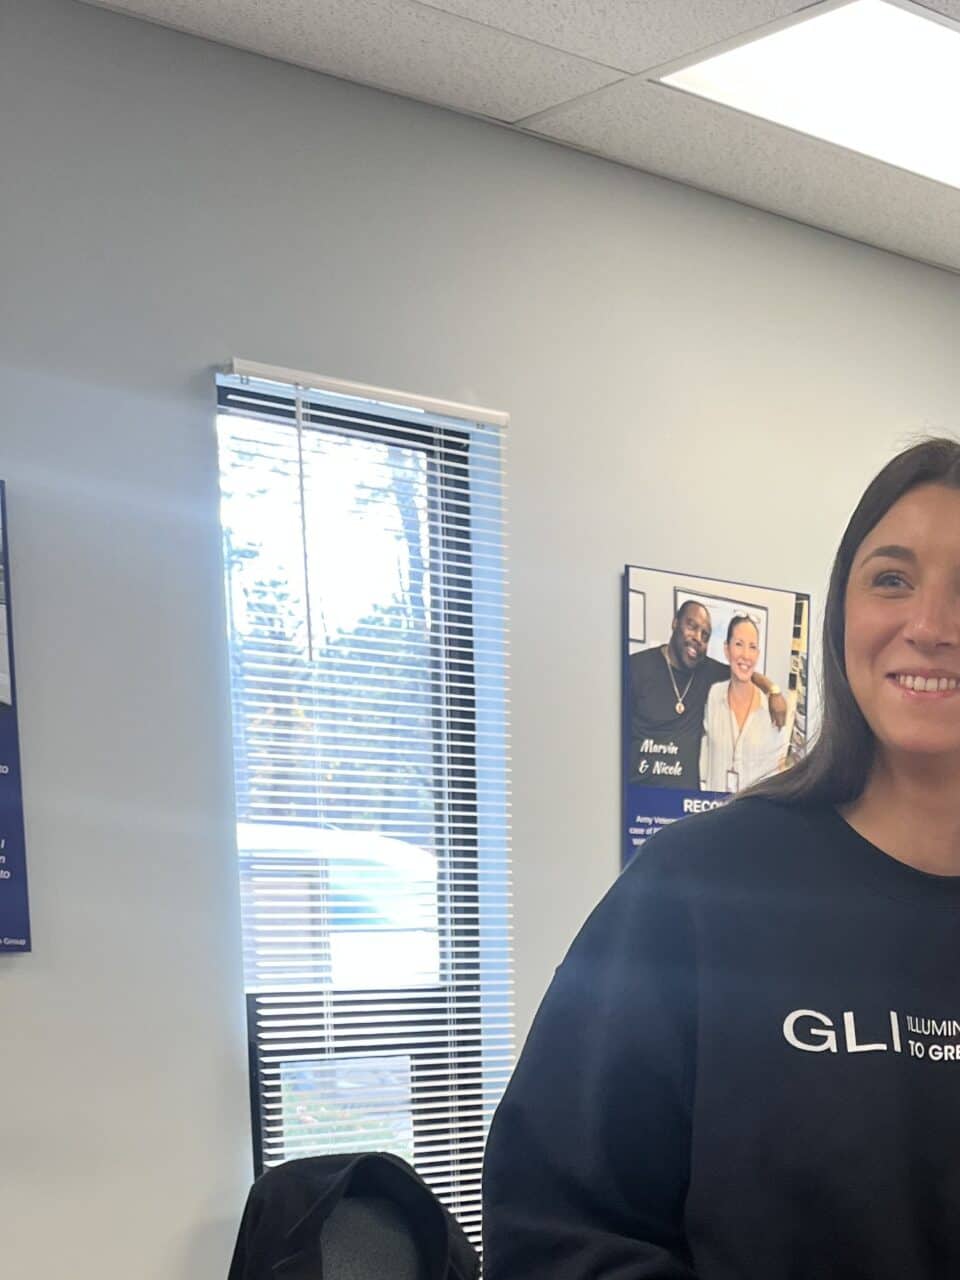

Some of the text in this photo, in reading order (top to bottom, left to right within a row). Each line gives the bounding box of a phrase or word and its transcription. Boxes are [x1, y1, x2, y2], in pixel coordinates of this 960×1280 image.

[640, 739, 678, 754] Marvin
[639, 760, 682, 776] & Nicole
[683, 799, 728, 813] RECO
[783, 1009, 902, 1053] GLI
[908, 1040, 924, 1058] TO
